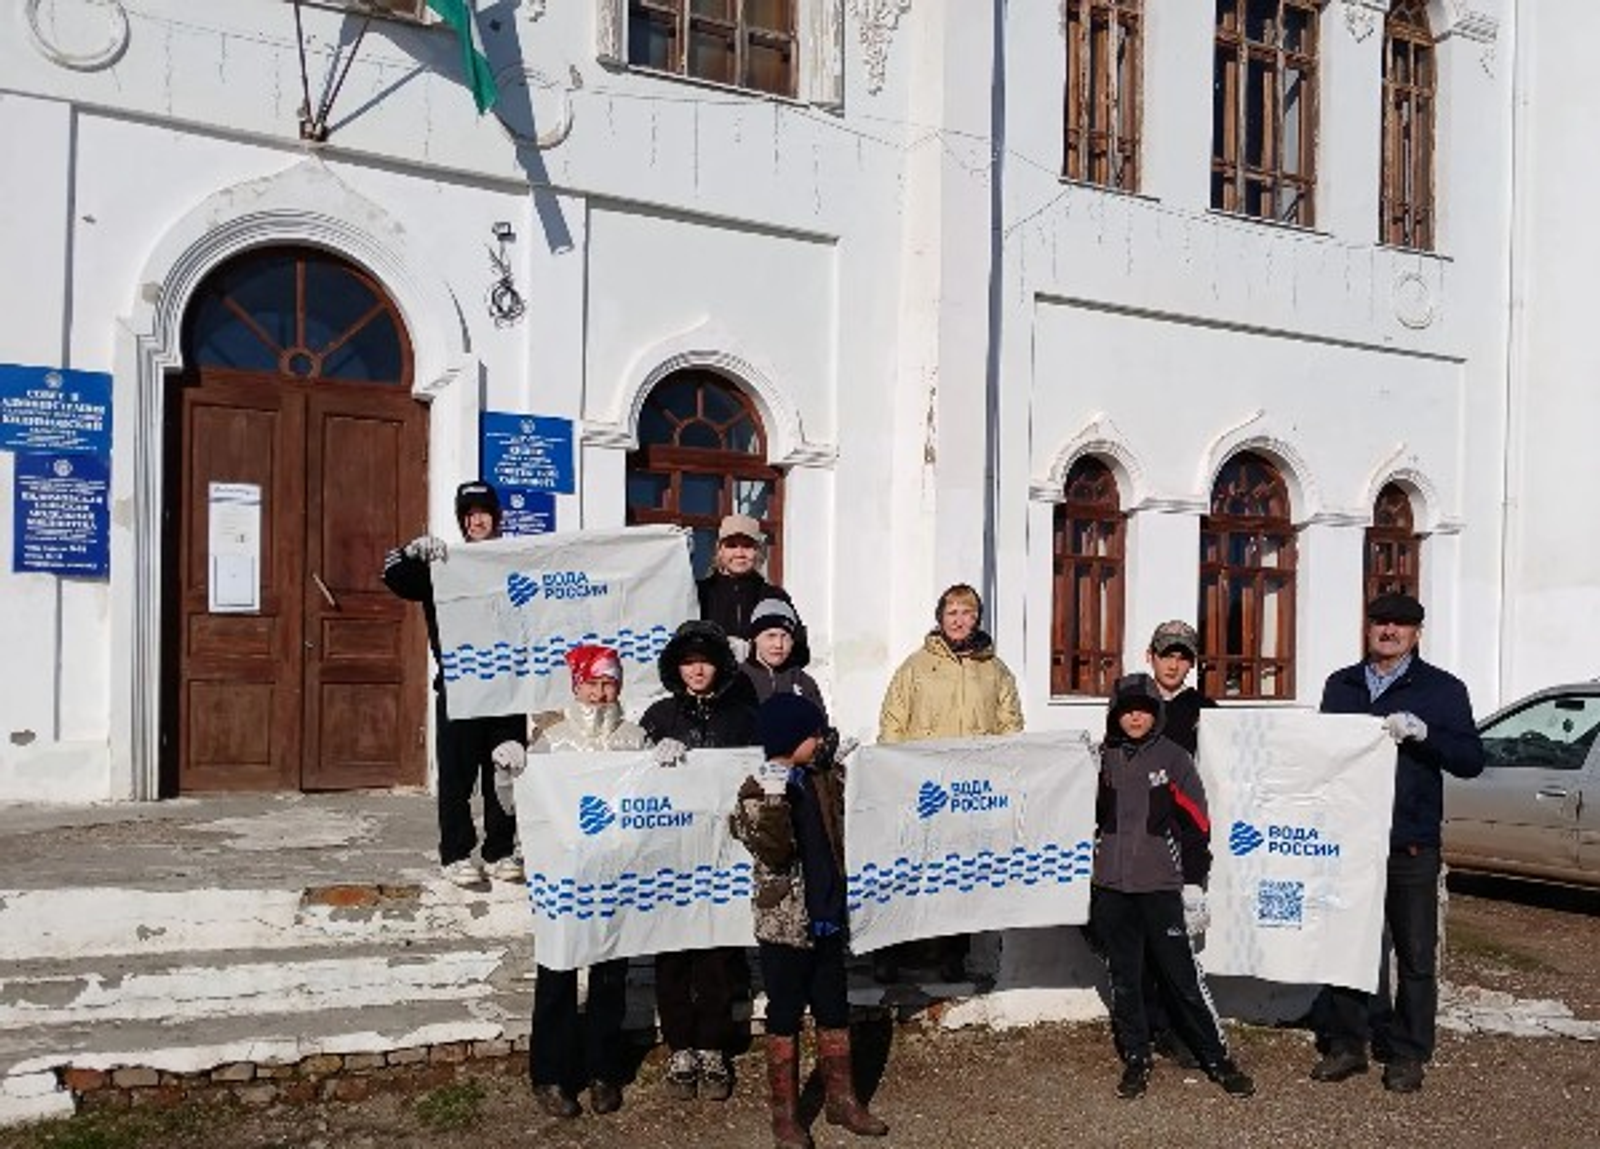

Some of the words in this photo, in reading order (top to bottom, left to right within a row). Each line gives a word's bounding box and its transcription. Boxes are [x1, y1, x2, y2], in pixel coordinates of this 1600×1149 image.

[542, 571, 589, 586] ВОДА
[544, 584, 608, 600] РОССИИ
[950, 779, 992, 796] ВОДА
[621, 796, 672, 813] ВОДА
[950, 795, 1009, 813] РОССИИ
[621, 811, 693, 829] РОССИИ
[1268, 825, 1319, 841] ВОДА
[1268, 841, 1340, 857] РОССИИ
